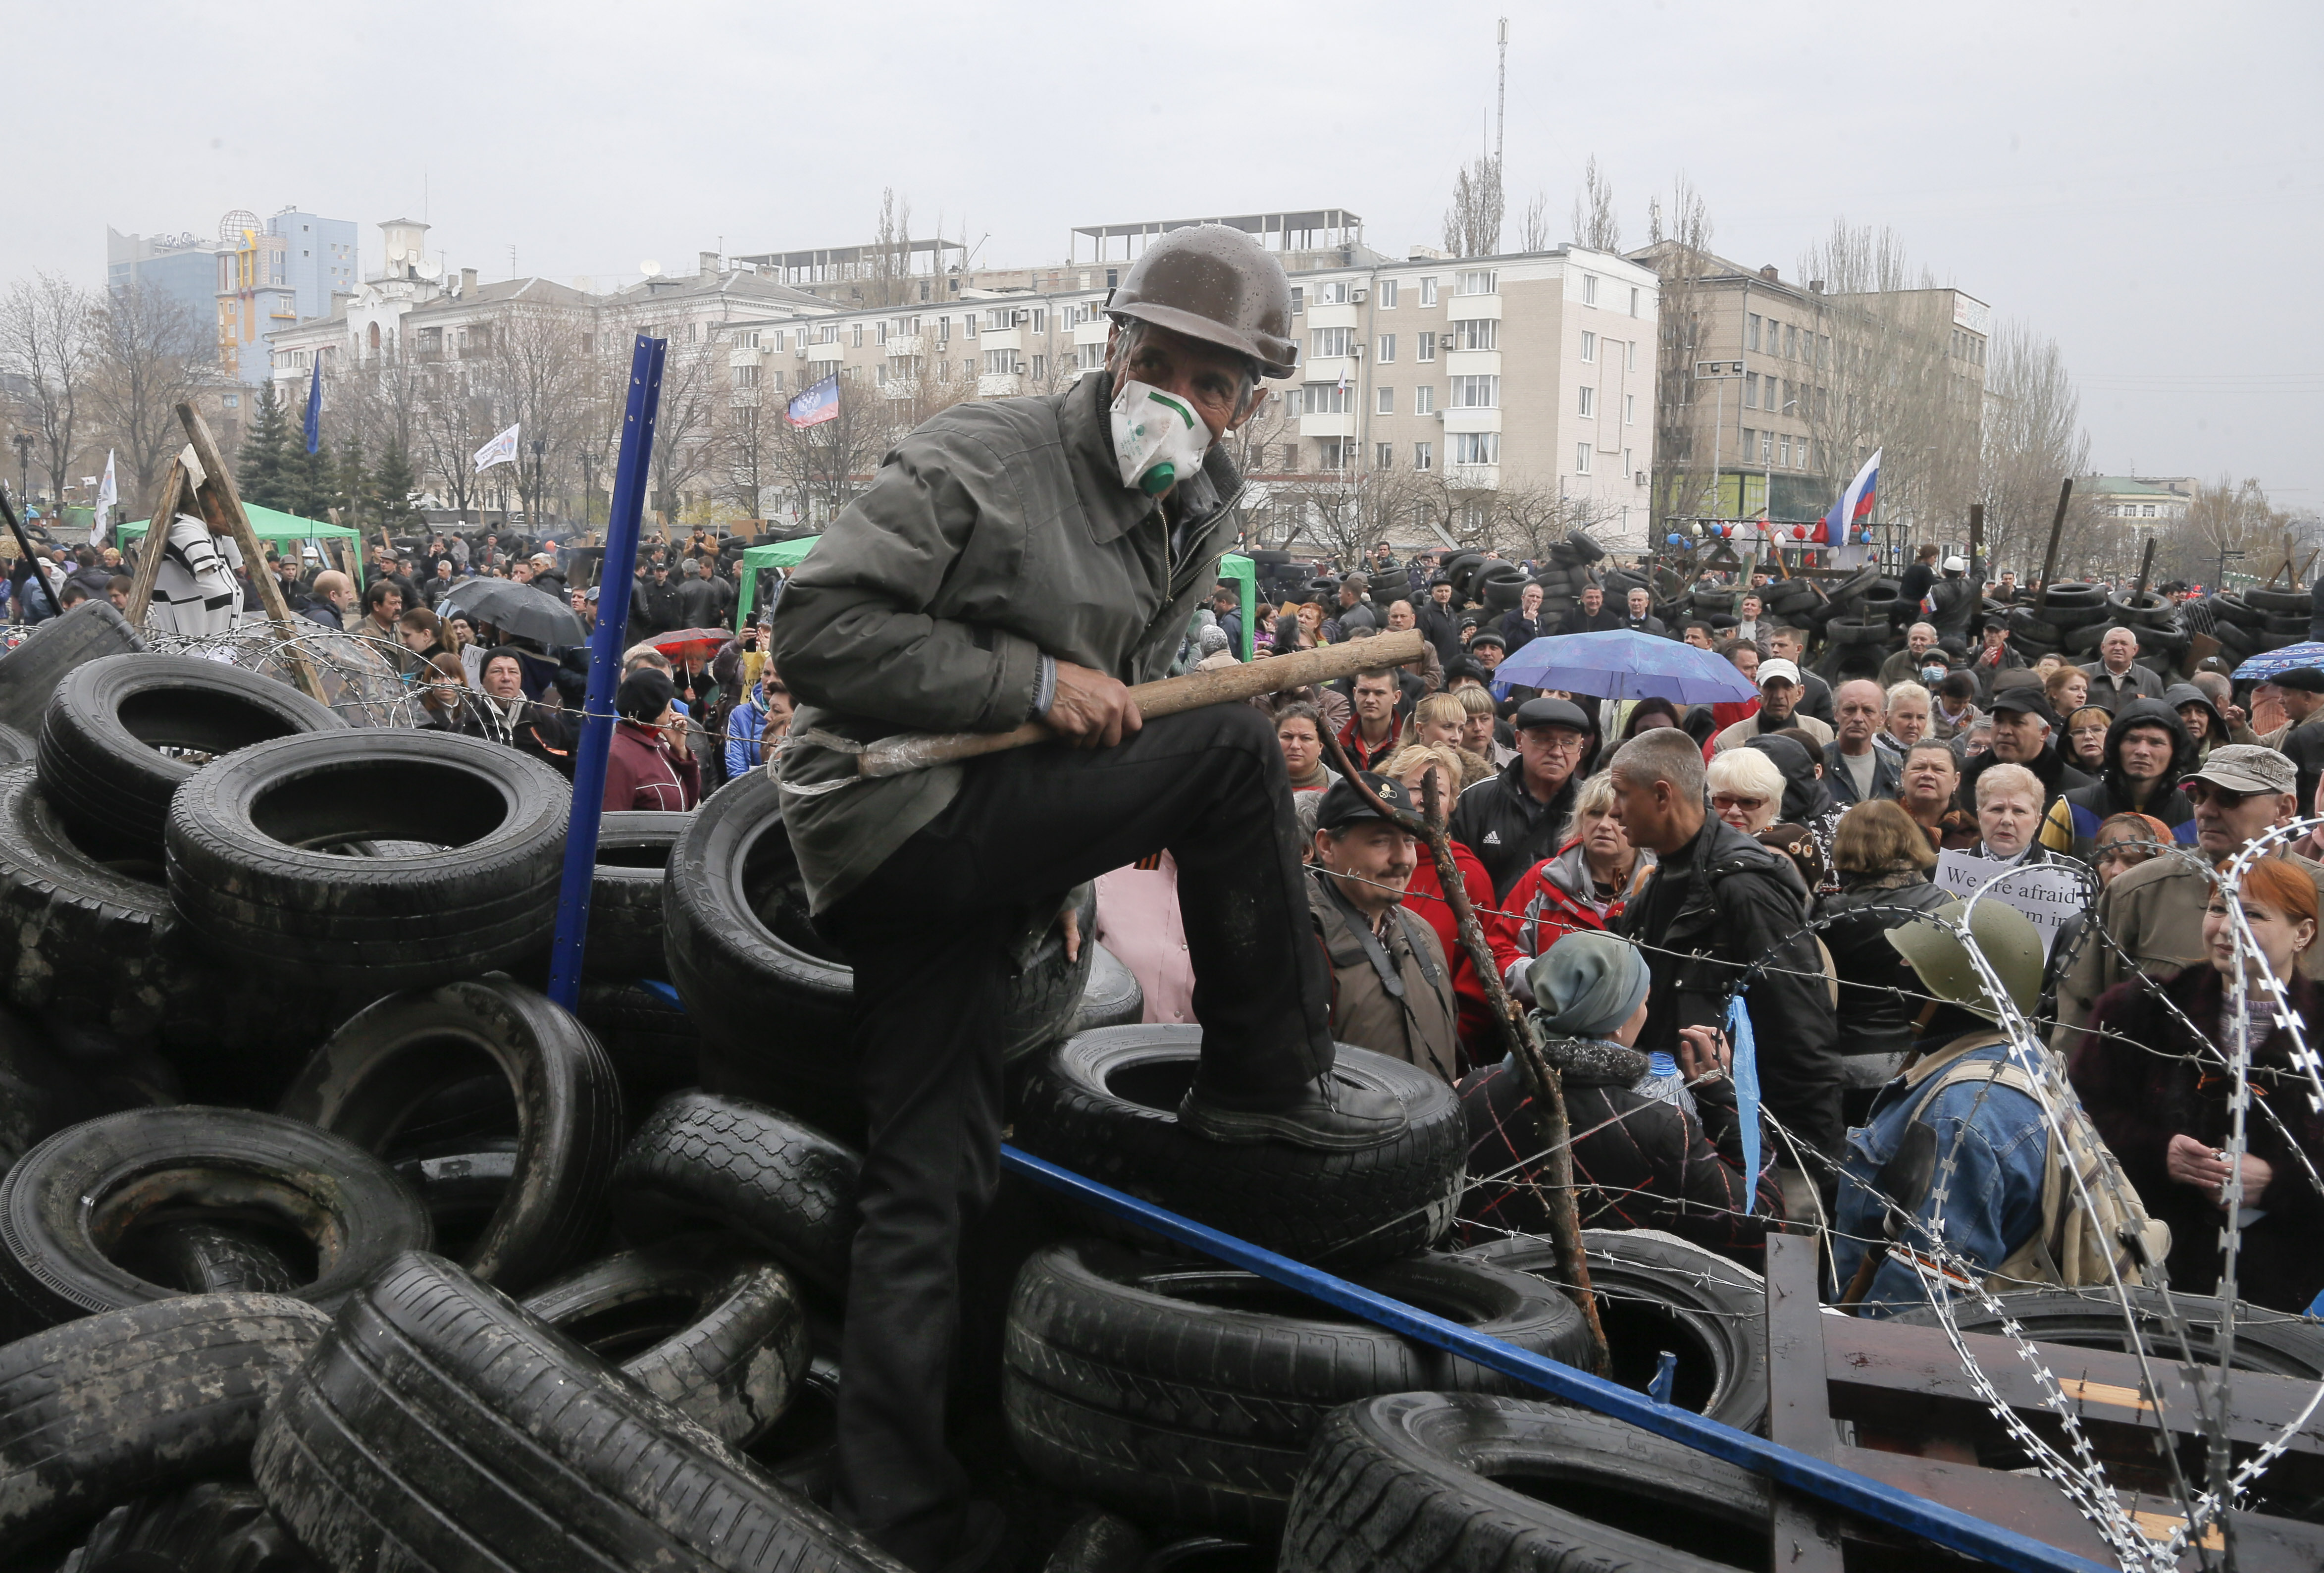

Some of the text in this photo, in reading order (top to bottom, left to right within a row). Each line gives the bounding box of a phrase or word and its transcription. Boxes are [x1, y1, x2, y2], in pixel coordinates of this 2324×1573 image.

[1947, 866, 2076, 904] We re afraid
